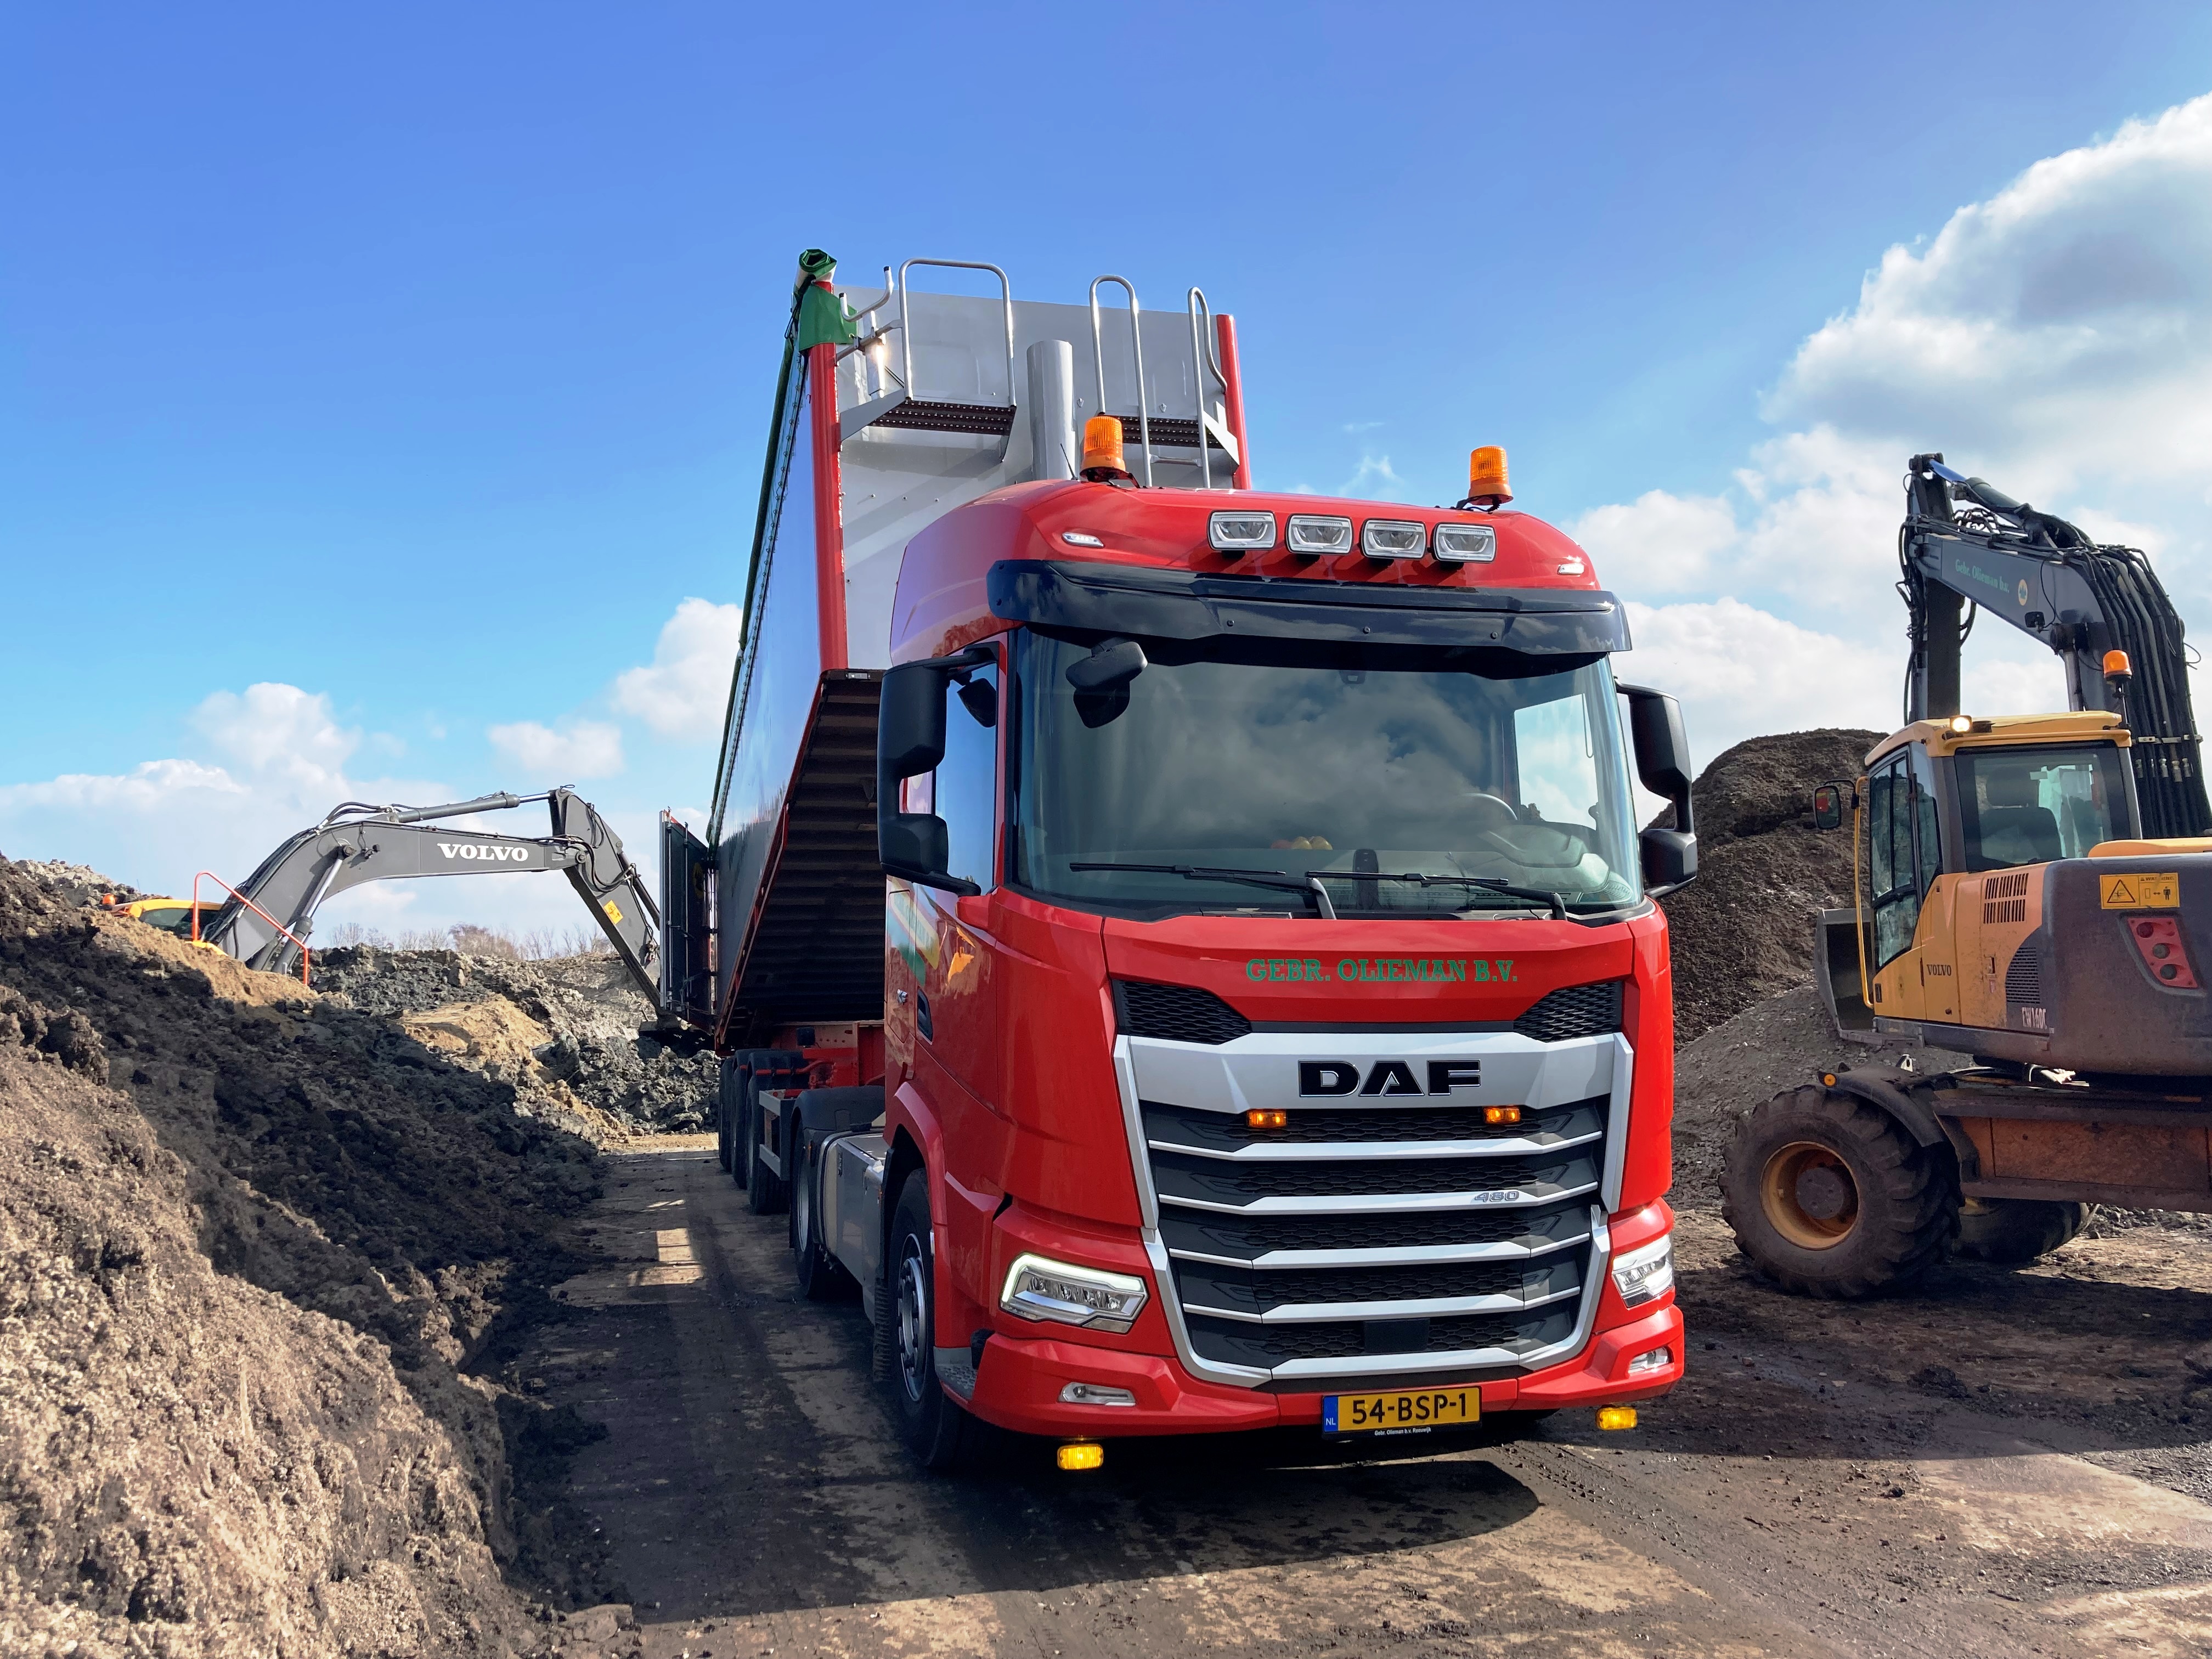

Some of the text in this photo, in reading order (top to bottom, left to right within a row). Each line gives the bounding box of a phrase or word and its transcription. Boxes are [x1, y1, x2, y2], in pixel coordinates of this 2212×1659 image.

[1955, 559, 1971, 577] Gebr.
[1972, 566, 1998, 589] Olieman
[437, 843, 529, 862] VOLVO
[1246, 958, 1517, 982] GEBR. OLIEMAN B.V.
[1926, 964, 1951, 977] VOLVO
[1298, 1059, 1481, 1097] DAF
[1475, 1190, 1519, 1202] 480
[1352, 1393, 1466, 1424] 54-BSP-1
